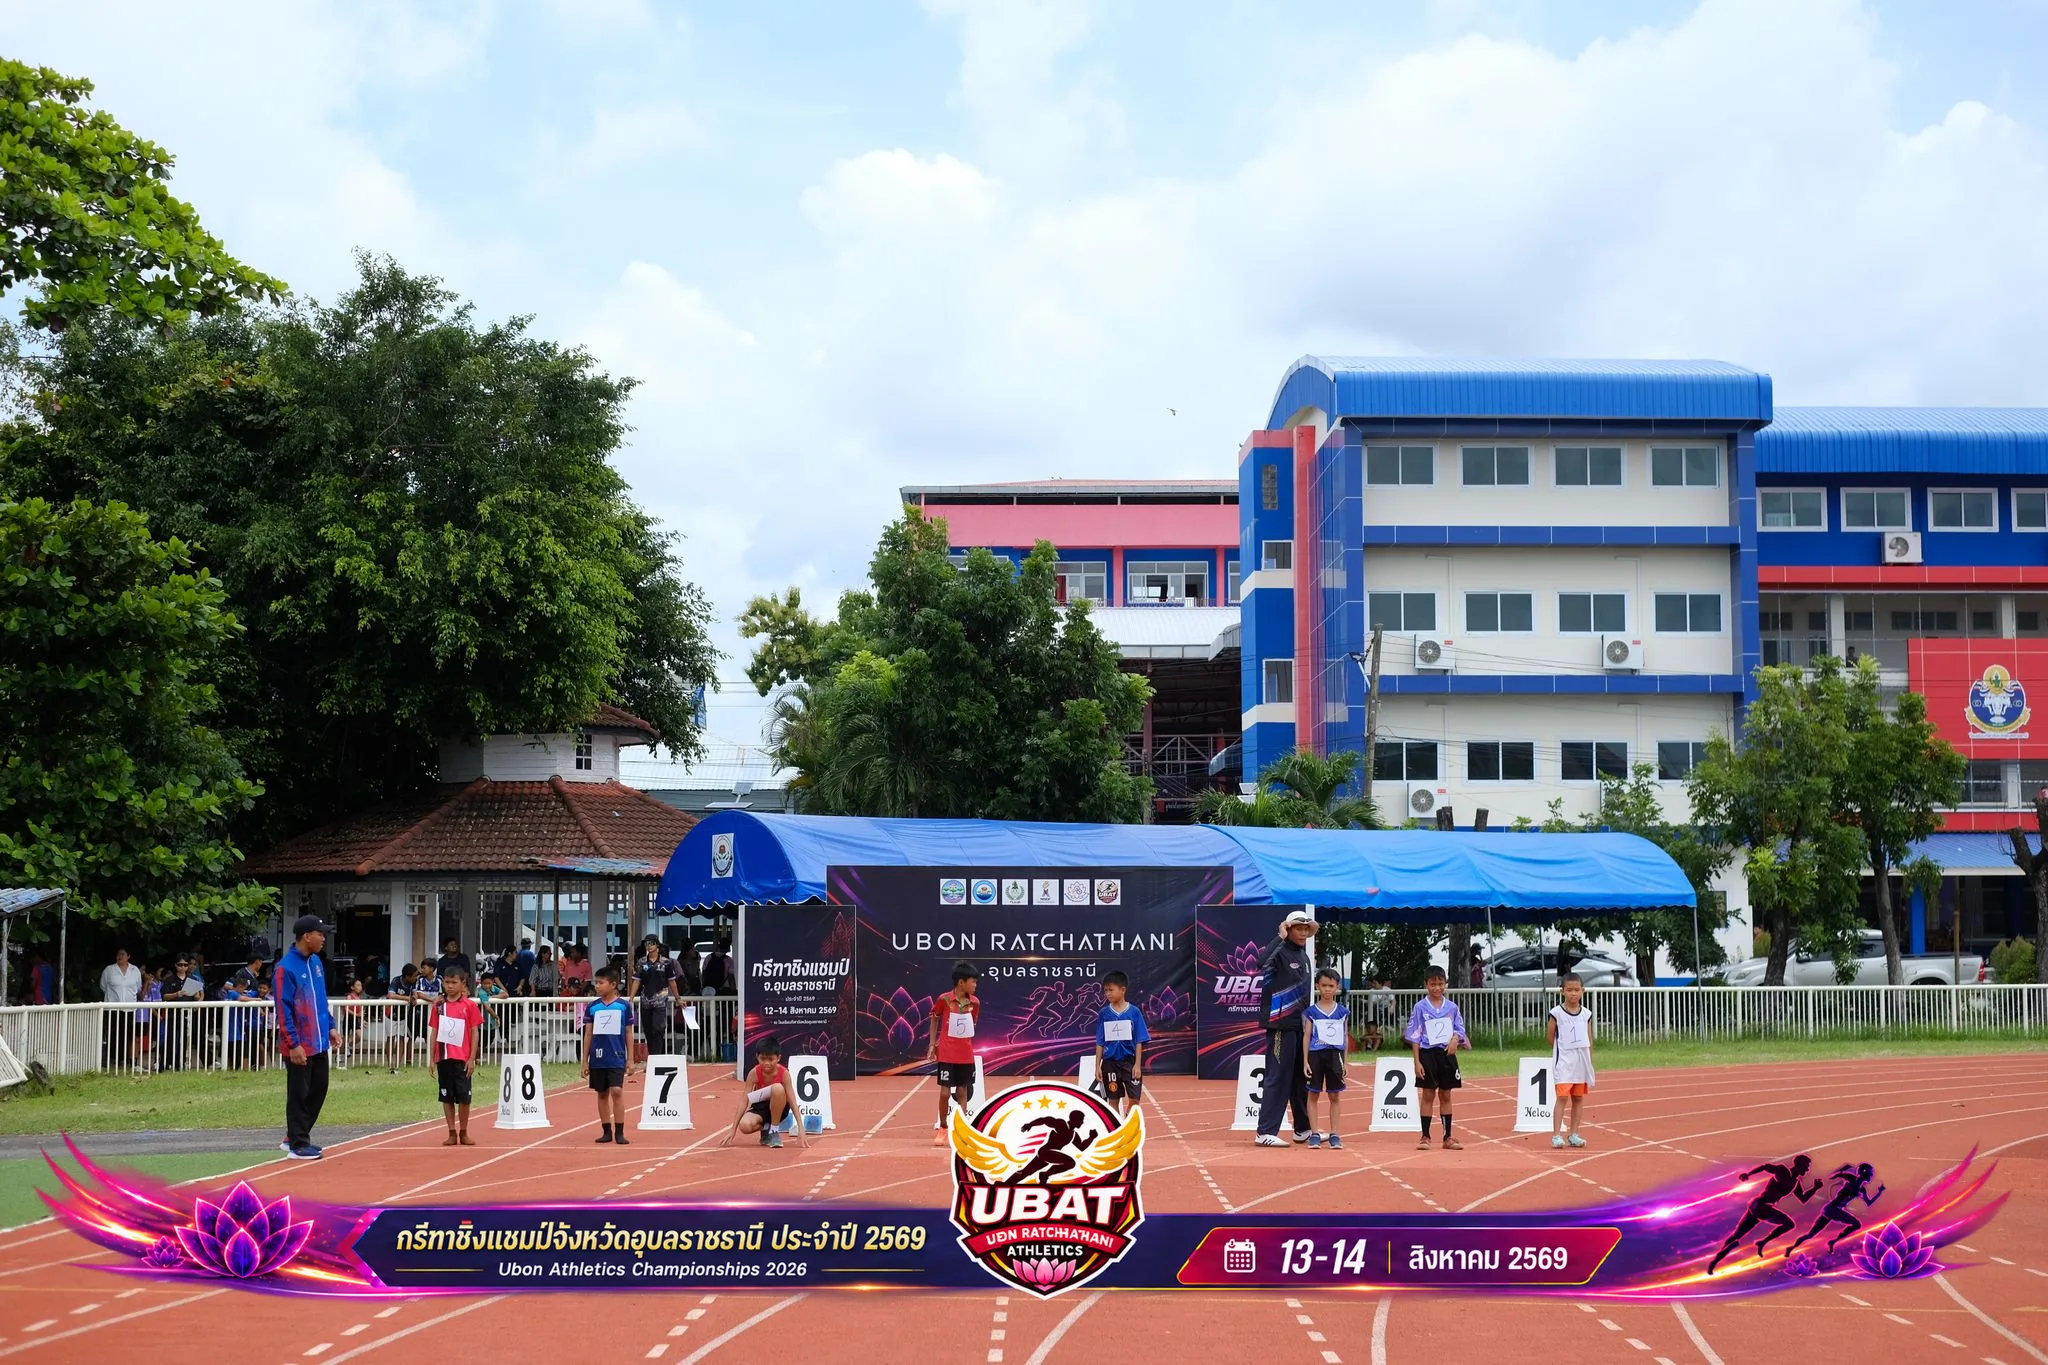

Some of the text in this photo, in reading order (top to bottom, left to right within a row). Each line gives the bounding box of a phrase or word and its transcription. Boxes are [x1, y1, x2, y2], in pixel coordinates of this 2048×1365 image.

[891, 932, 1175, 951] UBON RATCHATHANI
[751, 958, 851, 977] กรีฑาชิงแชมป์
[980, 962, 1097, 982] .อุบลราชธานี
[763, 977, 837, 995] จ.อุบลราชธานี
[764, 1005, 838, 1015] 12-14 สิงหาคม 2569
[447, 1018, 456, 1039] 8
[599, 1014, 612, 1029] 7
[955, 1017, 968, 1036] 5
[1112, 1023, 1123, 1038] 4
[1325, 1022, 1337, 1038] 3
[1434, 1021, 1448, 1040] 2
[1569, 1026, 1582, 1044] 1
[595, 1047, 603, 1059] 10
[503, 1066, 512, 1103] 8
[521, 1064, 536, 1101] 8
[796, 1065, 820, 1103] 6
[940, 1070, 950, 1081] 12
[1107, 1072, 1117, 1082] 10
[654, 1066, 679, 1104] 7
[1249, 1067, 1266, 1105] 3
[1383, 1069, 1408, 1106] 2
[1530, 1068, 1547, 1106] 1
[521, 1103, 538, 1114] Nelco
[650, 1106, 679, 1117] Nelco
[799, 1105, 821, 1116] elco
[1381, 1109, 1409, 1119] Nelco
[1524, 1106, 1551, 1118] Nelco
